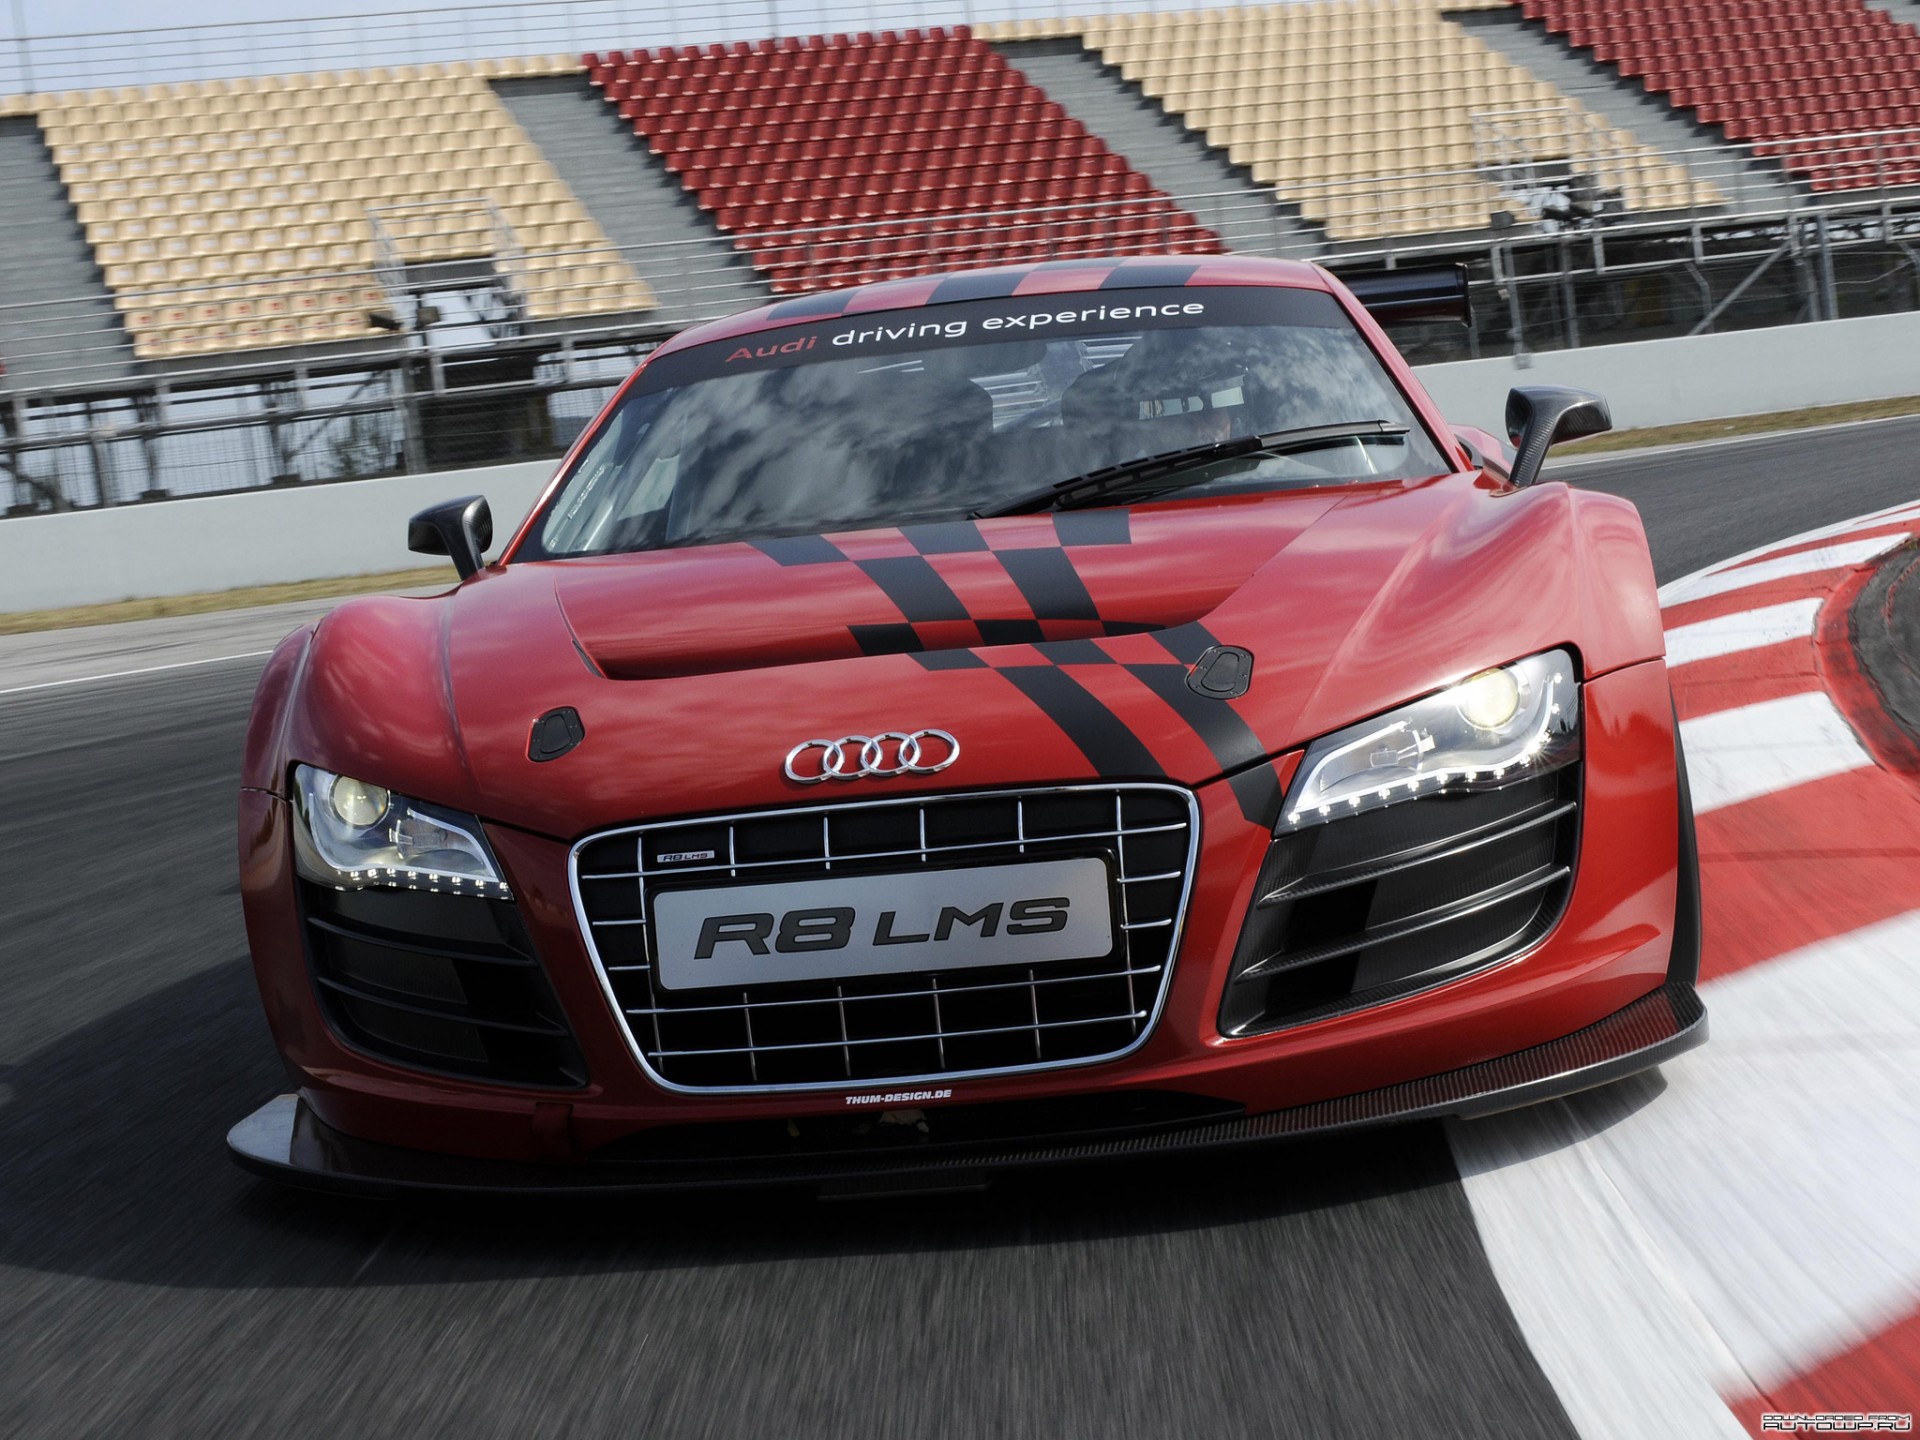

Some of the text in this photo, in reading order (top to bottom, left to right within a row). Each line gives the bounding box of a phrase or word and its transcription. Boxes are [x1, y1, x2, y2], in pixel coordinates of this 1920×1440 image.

[725, 300, 1206, 363] Audi driving experience
[693, 896, 1071, 961] R8 LMS
[845, 1089, 953, 1105] THUM-DESIGN.DE
